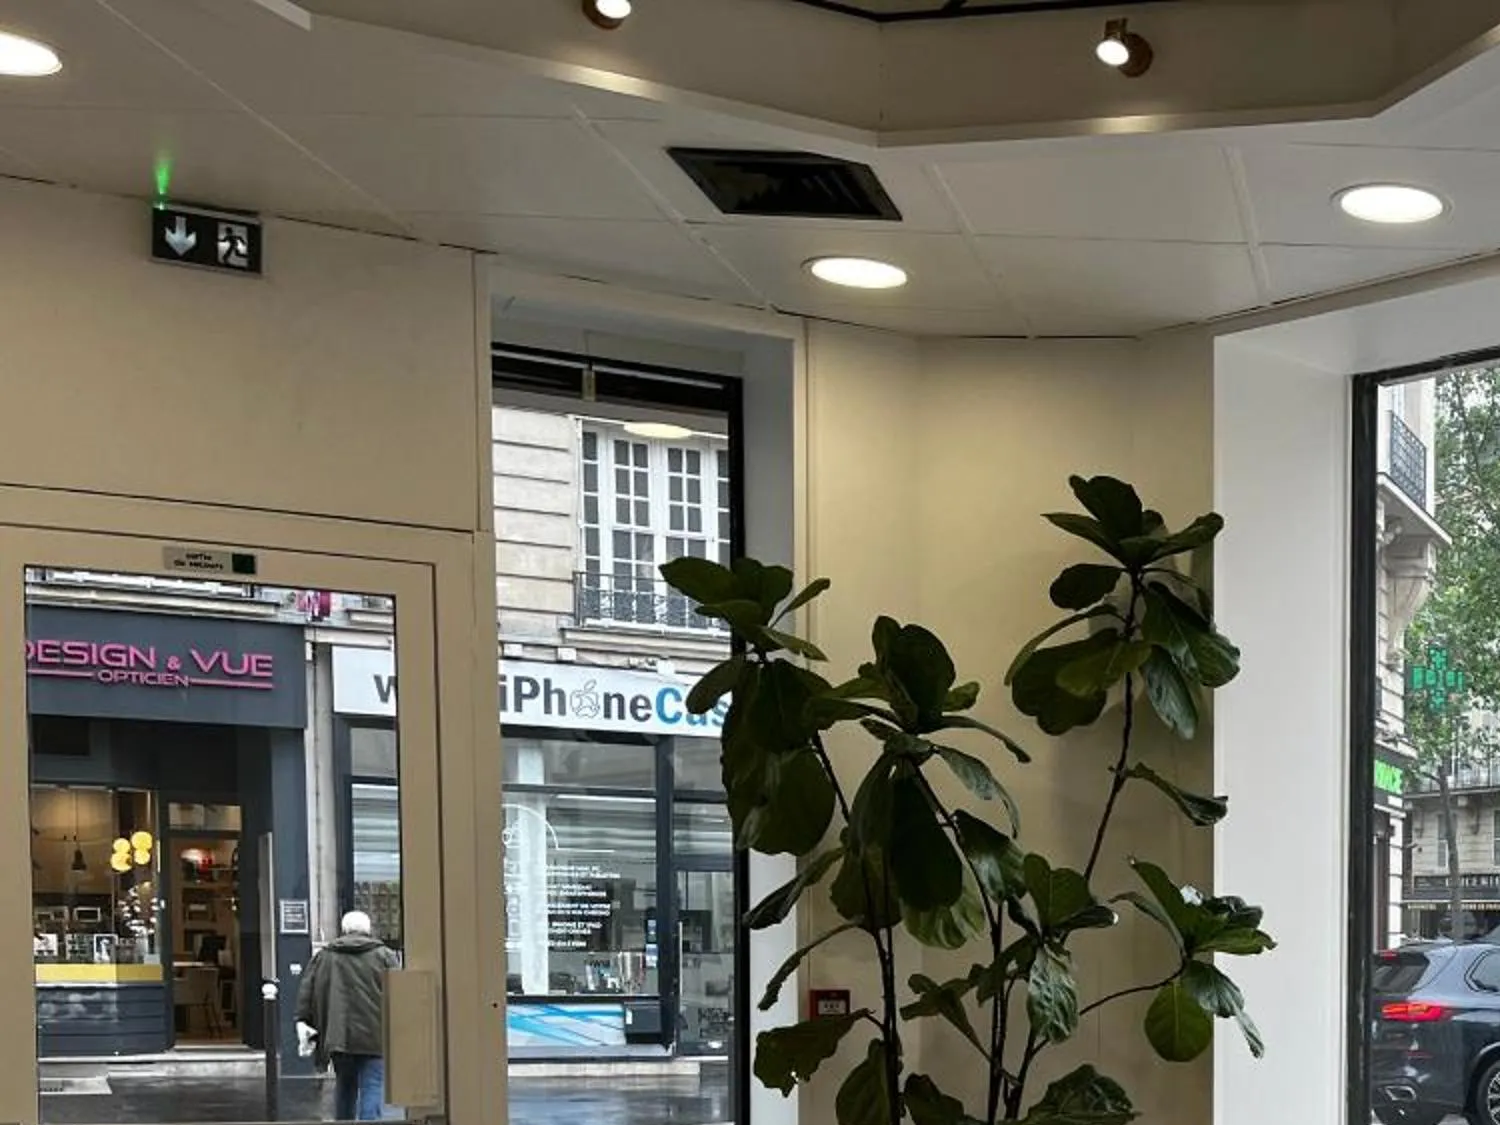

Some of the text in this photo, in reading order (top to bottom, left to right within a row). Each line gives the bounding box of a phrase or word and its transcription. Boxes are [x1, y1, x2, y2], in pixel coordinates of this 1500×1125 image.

[167, 655, 181, 670] &
[190, 648, 273, 677] VUE
[98, 669, 189, 687] OPTICIEN
